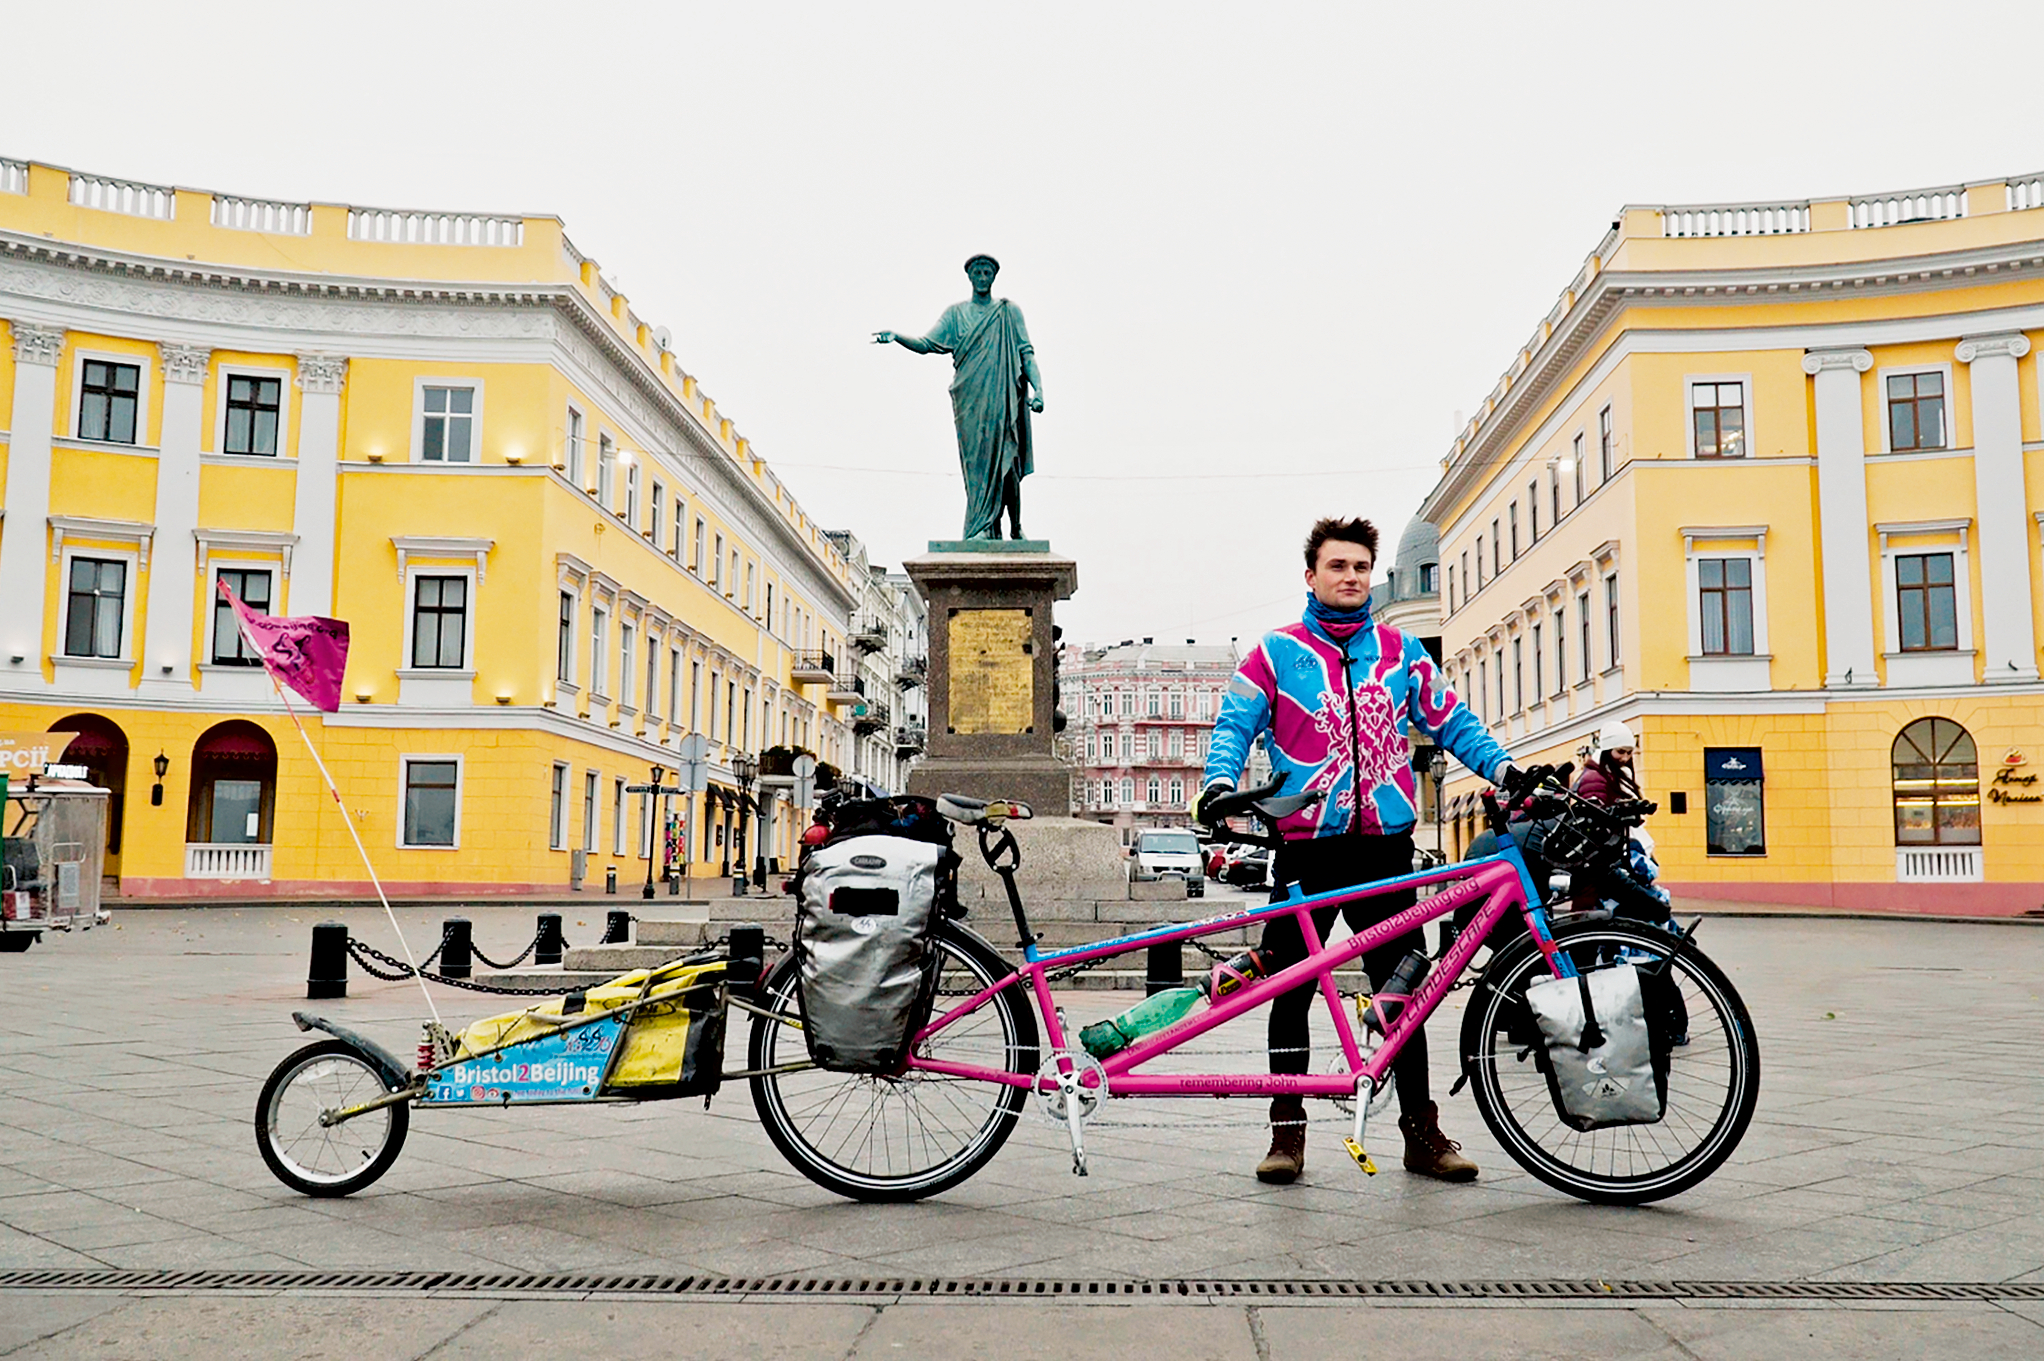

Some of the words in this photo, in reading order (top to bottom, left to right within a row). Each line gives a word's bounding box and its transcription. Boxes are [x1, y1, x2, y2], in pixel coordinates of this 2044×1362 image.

[1347, 877, 1480, 950] Bristol2Beijing.org
[1404, 904, 1496, 1022] LANDESCAPE
[454, 1063, 600, 1086] Bristol2Beijing
[1179, 1076, 1264, 1090] remembering
[1266, 1076, 1299, 1088] John
